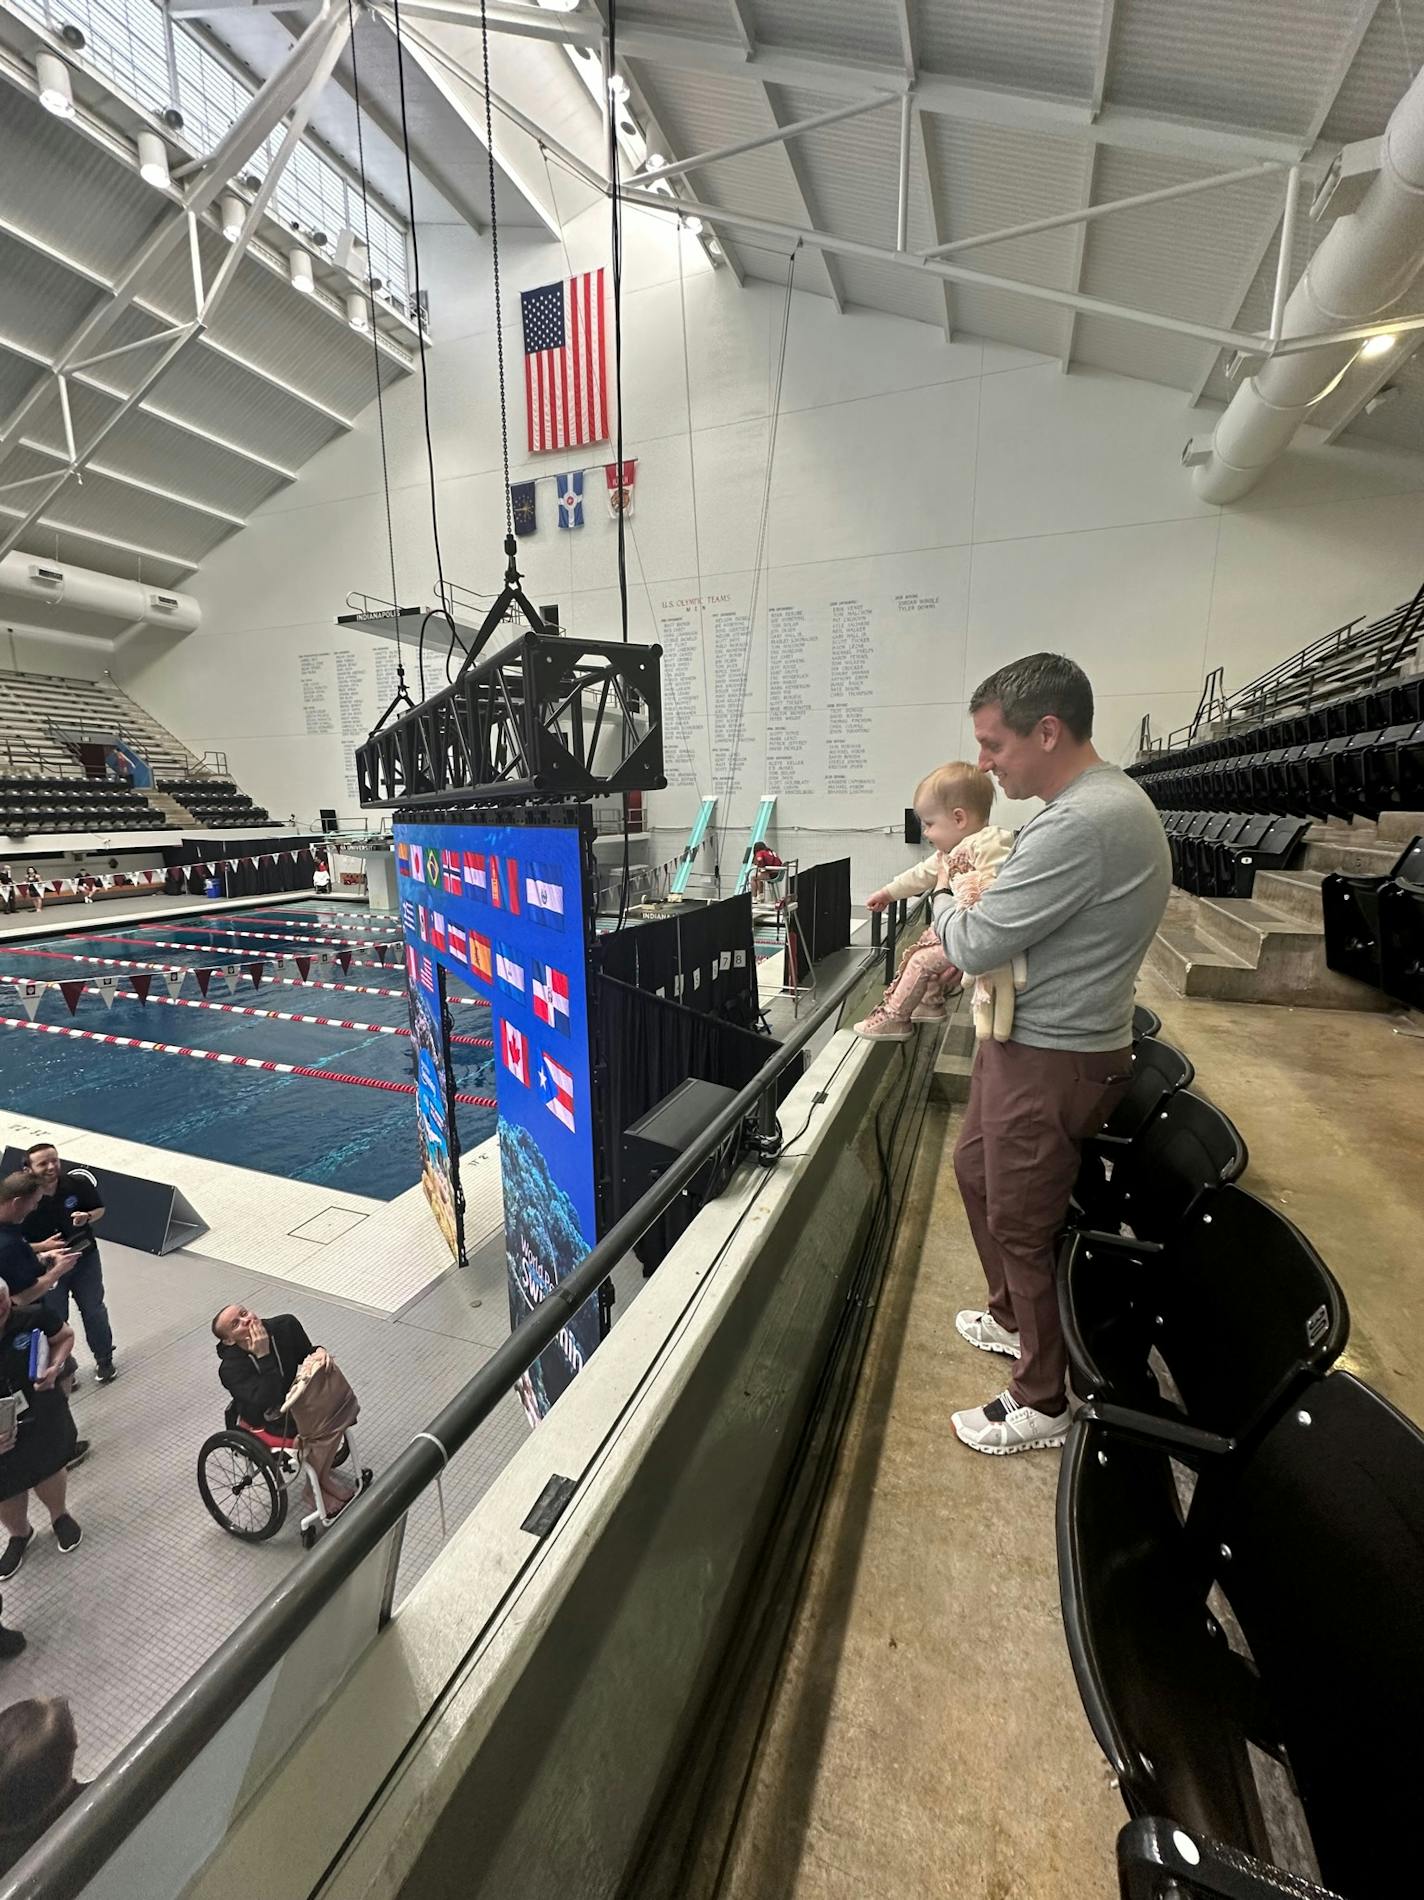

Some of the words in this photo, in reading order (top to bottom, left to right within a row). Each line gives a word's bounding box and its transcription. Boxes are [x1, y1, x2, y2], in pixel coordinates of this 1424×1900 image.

[676, 597, 704, 607] OLYMPIC
[707, 594, 731, 604] TEAMS
[356, 609, 401, 622] INDIANAPOLIS
[722, 957, 729, 968] 7
[735, 954, 743, 965] 8
[520, 1234, 544, 1279] World
